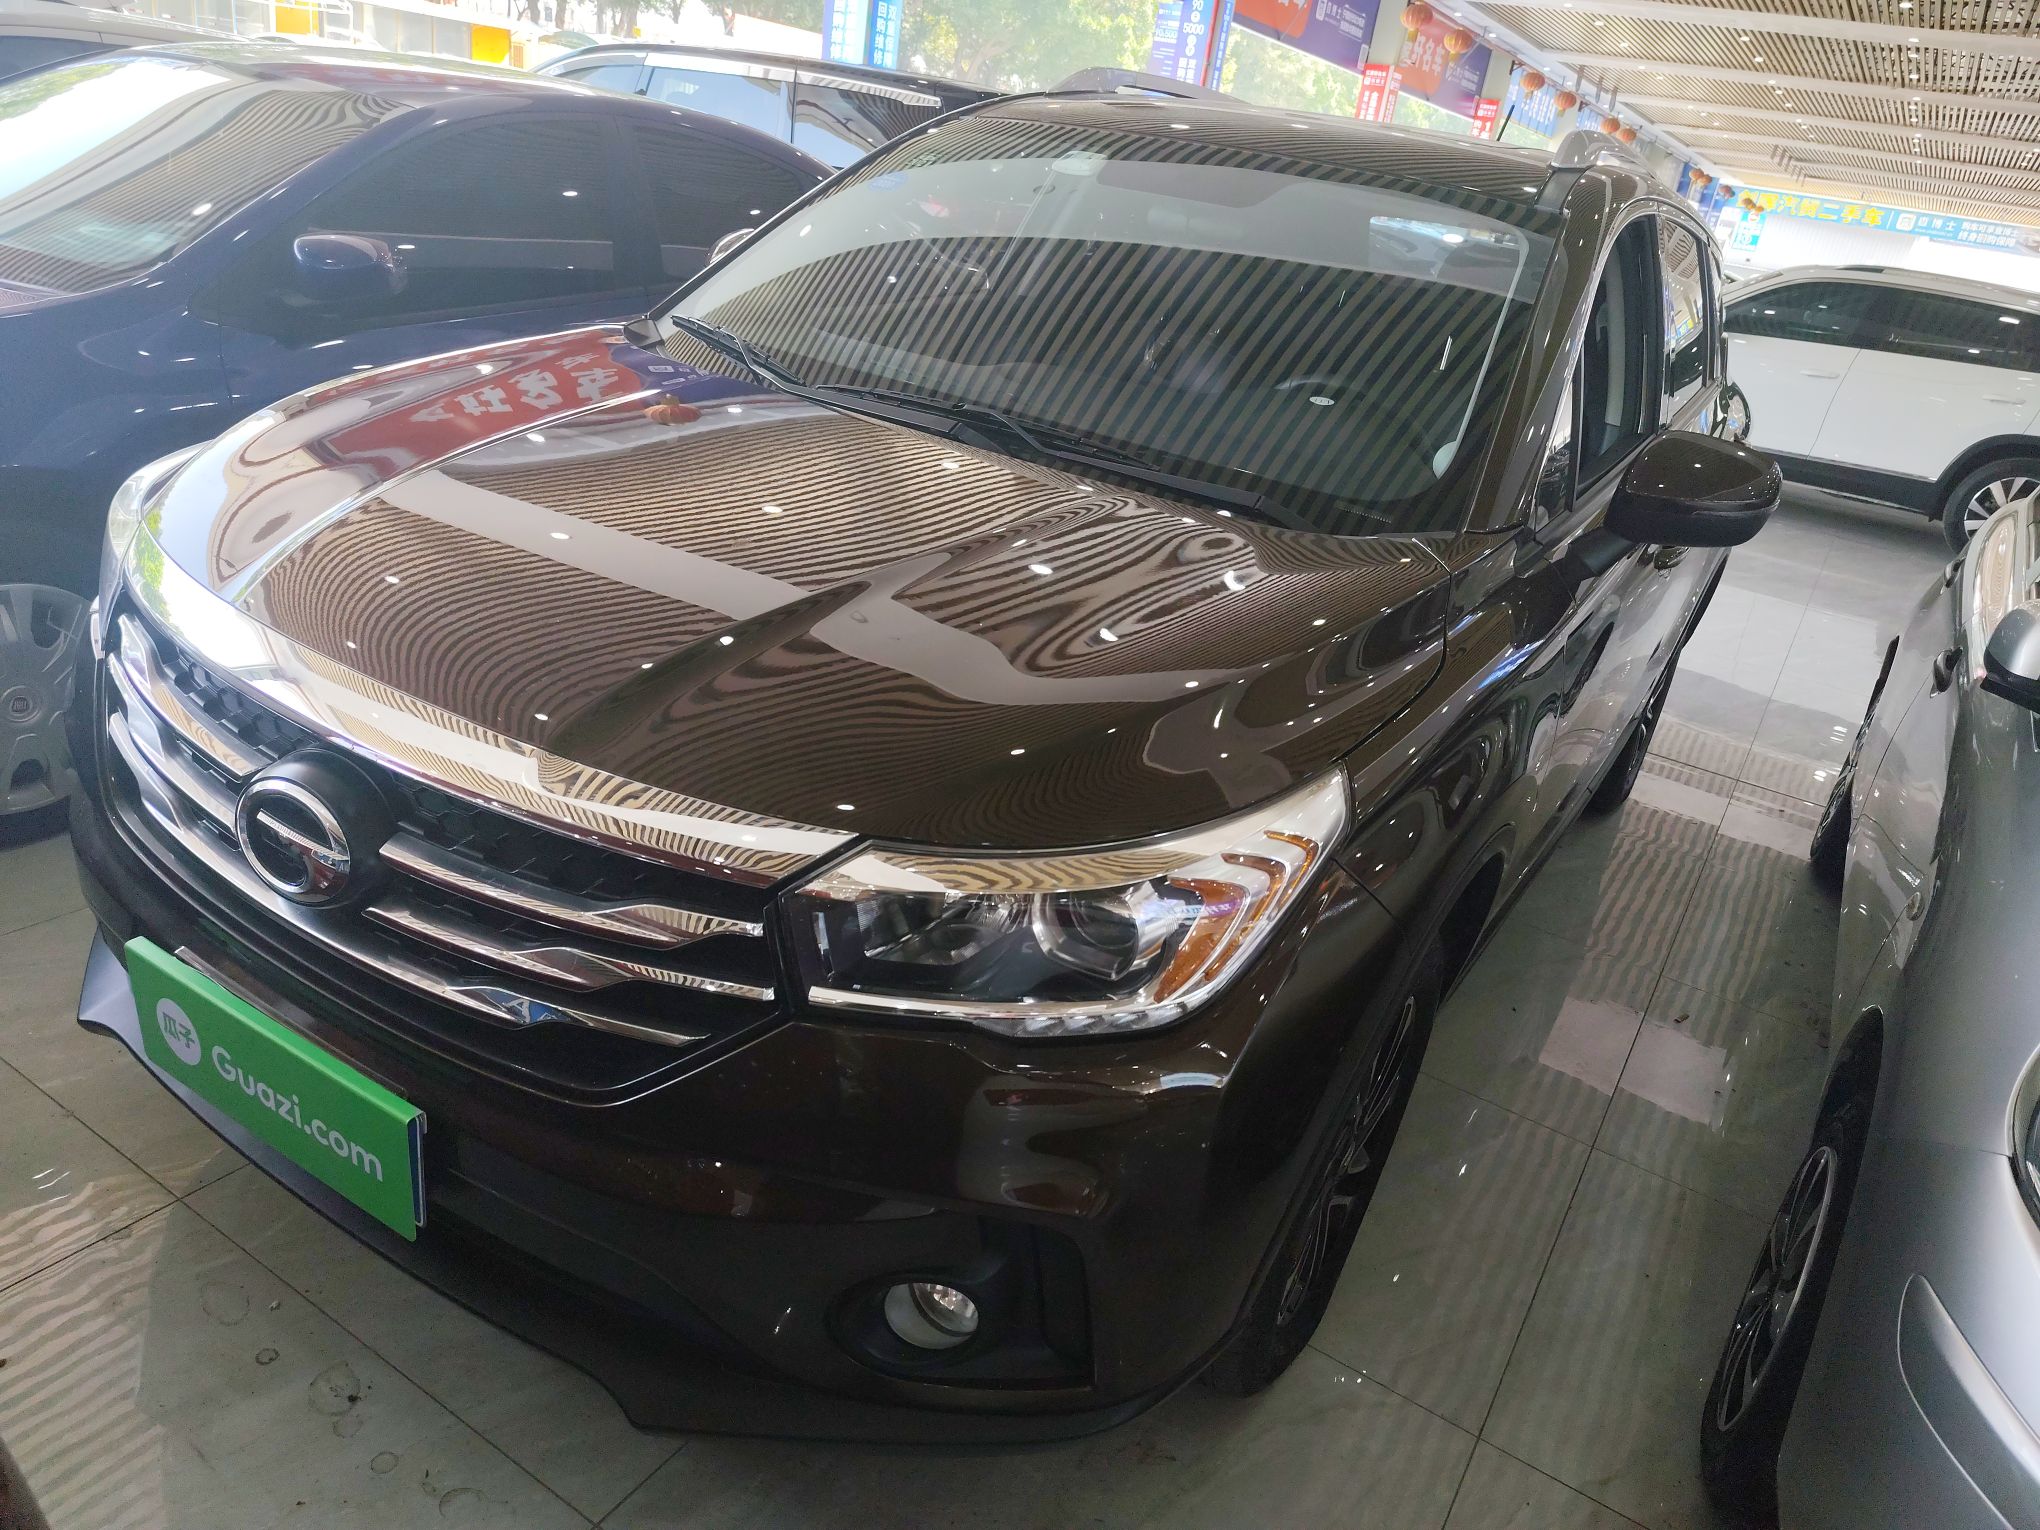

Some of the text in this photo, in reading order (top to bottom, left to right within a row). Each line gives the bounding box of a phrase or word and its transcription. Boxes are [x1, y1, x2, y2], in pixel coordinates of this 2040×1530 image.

[1183, 22, 1204, 35] 5000
[162, 1011, 196, 1049] 瓜子
[212, 1045, 384, 1182] Guazi.com
